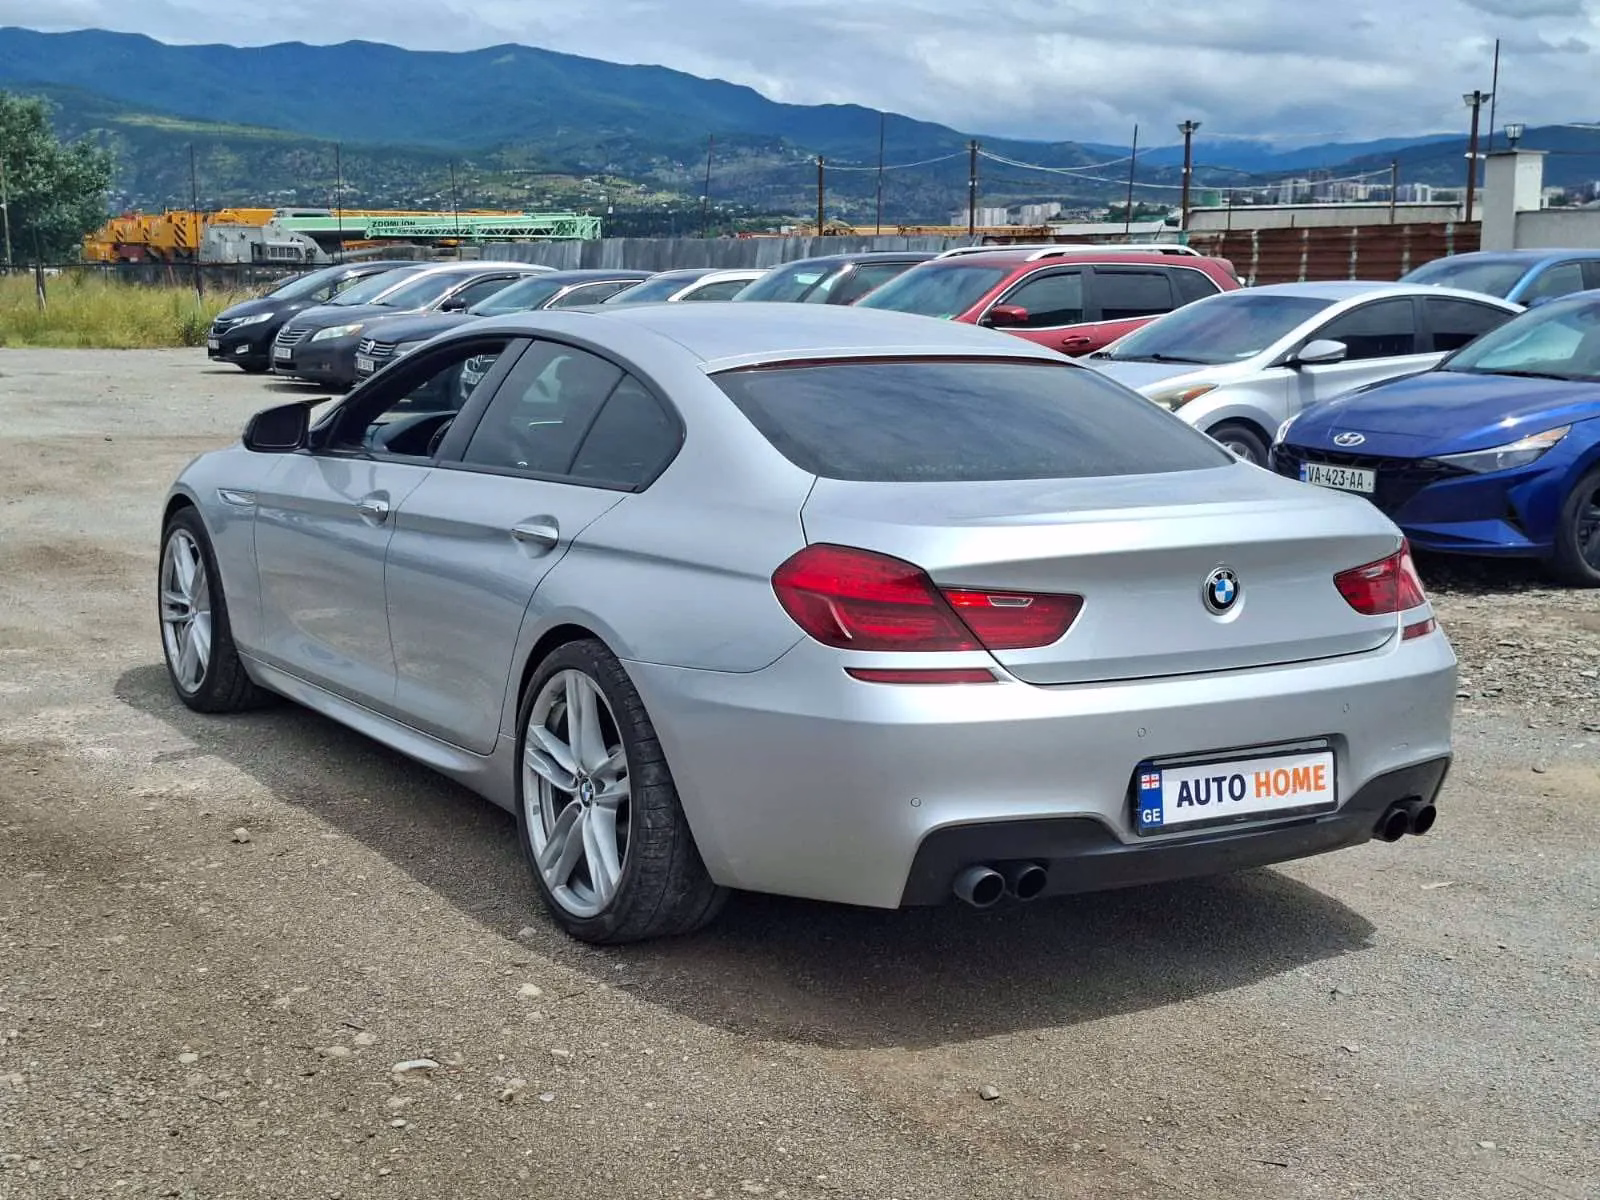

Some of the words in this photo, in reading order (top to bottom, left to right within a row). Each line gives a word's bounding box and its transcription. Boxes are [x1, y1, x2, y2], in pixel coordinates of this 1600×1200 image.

[1308, 466, 1364, 489] VA-423-AA
[1177, 773, 1246, 808] AUTO
[1254, 765, 1326, 798] HOME
[1142, 808, 1160, 823] GE
